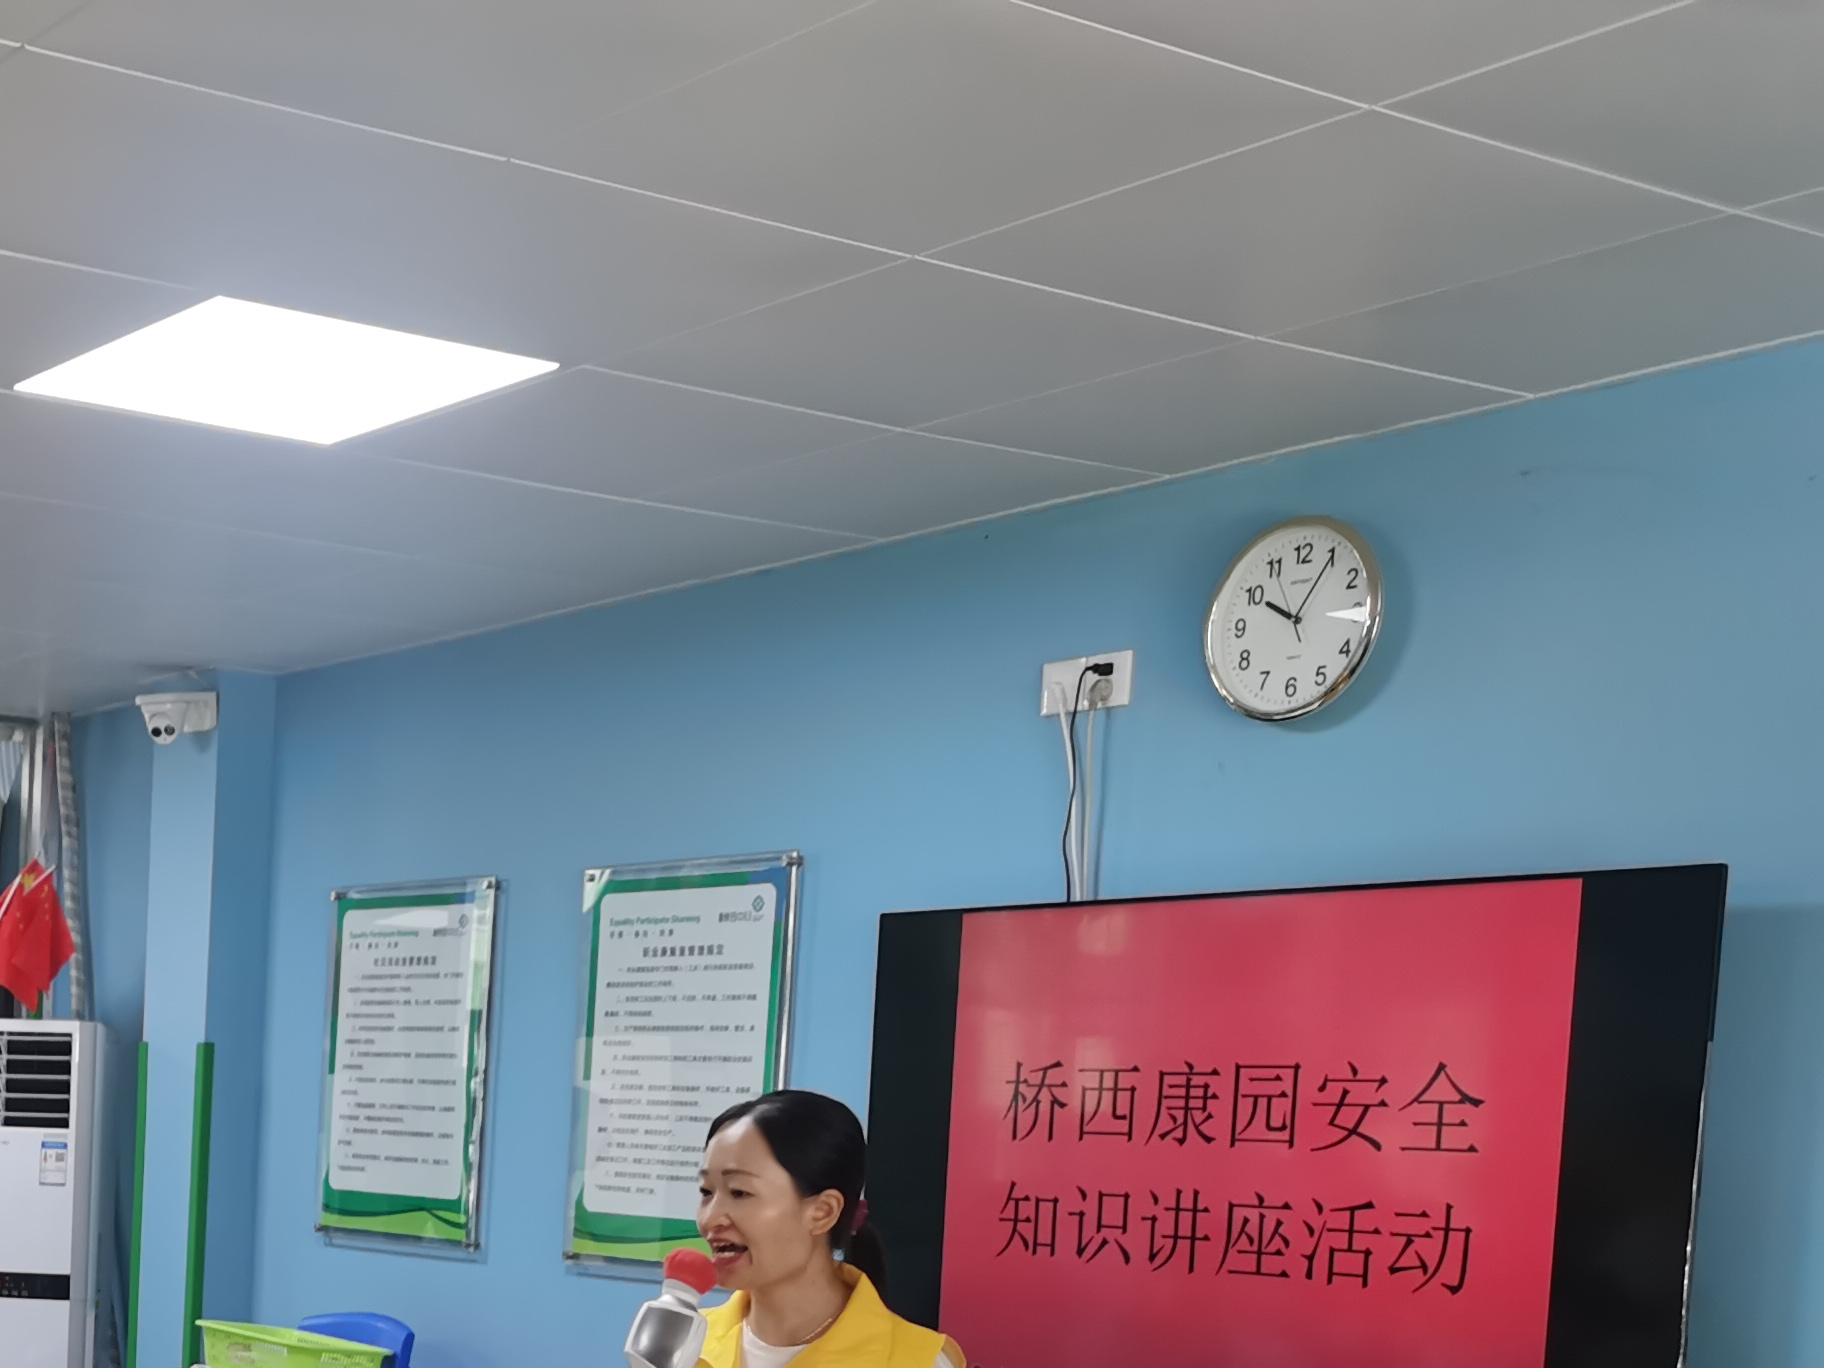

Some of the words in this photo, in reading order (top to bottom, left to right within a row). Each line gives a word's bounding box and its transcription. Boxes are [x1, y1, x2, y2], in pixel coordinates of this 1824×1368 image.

[1294, 543, 1314, 564] 12
[1327, 546, 1336, 568] 1
[1266, 557, 1283, 578] 11
[1345, 568, 1359, 589] 2
[1245, 584, 1264, 606] 10
[1234, 618, 1247, 638] 9
[1338, 638, 1351, 658] 4
[1238, 649, 1251, 671] 8
[1259, 670, 1270, 691] 7
[1314, 665, 1327, 686] 5
[1284, 676, 1297, 697] 6
[1002, 1060, 1486, 1154] 桥西康园安全
[996, 1179, 1473, 1296] 知识讲座活动
